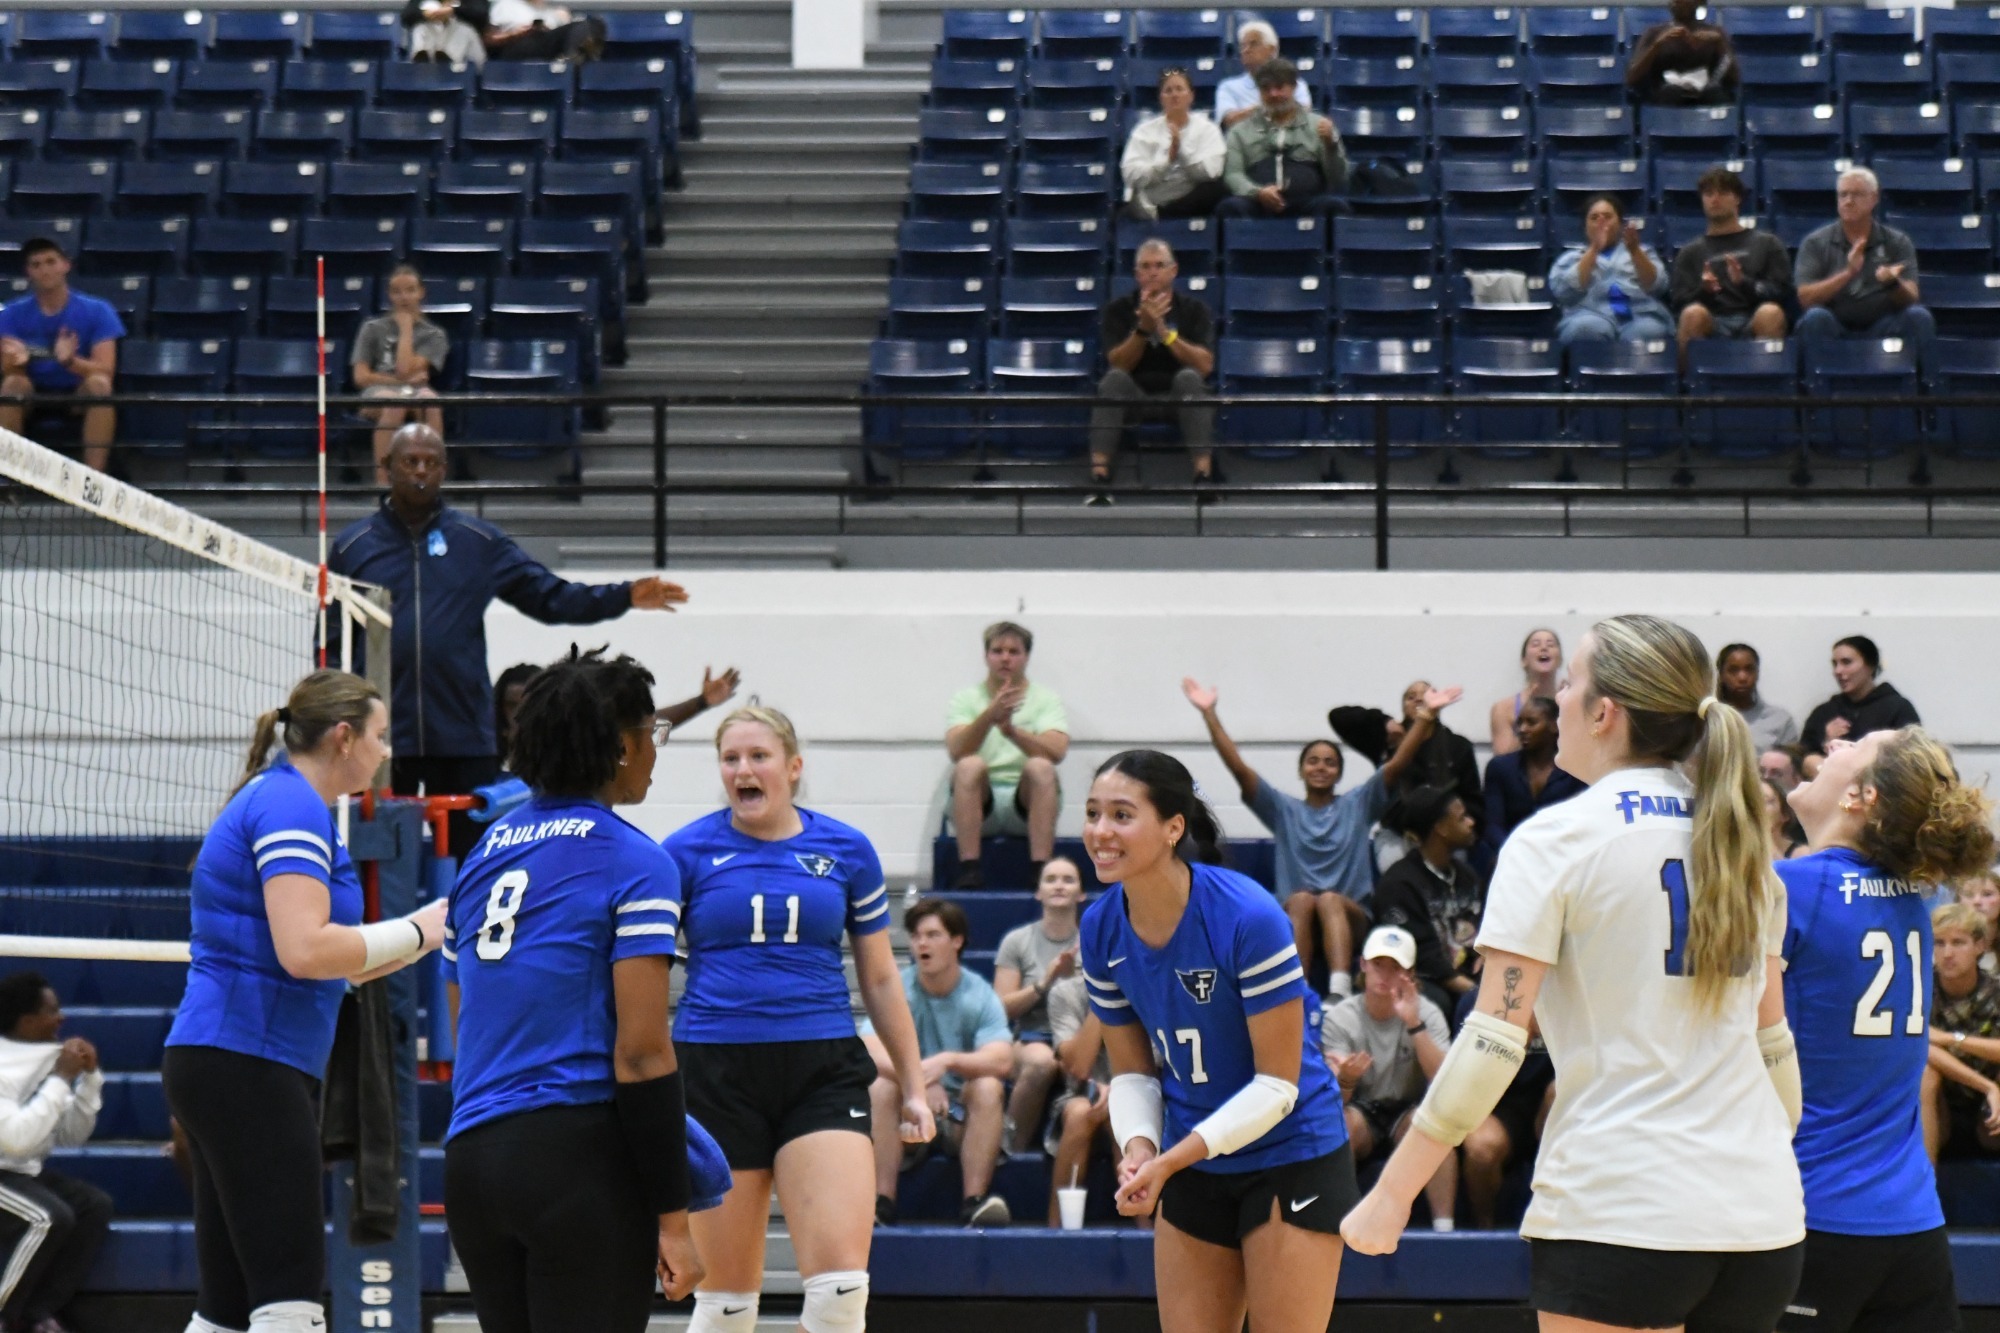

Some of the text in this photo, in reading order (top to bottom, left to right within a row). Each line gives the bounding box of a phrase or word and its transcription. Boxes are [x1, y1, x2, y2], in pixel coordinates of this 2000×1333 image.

[484, 817, 596, 858] FAULKNER
[1838, 872, 1923, 904] FAULKNE
[475, 868, 529, 962] 8
[750, 893, 800, 944] 11
[1852, 929, 1925, 1037] 21
[1156, 1028, 1209, 1084] 17
